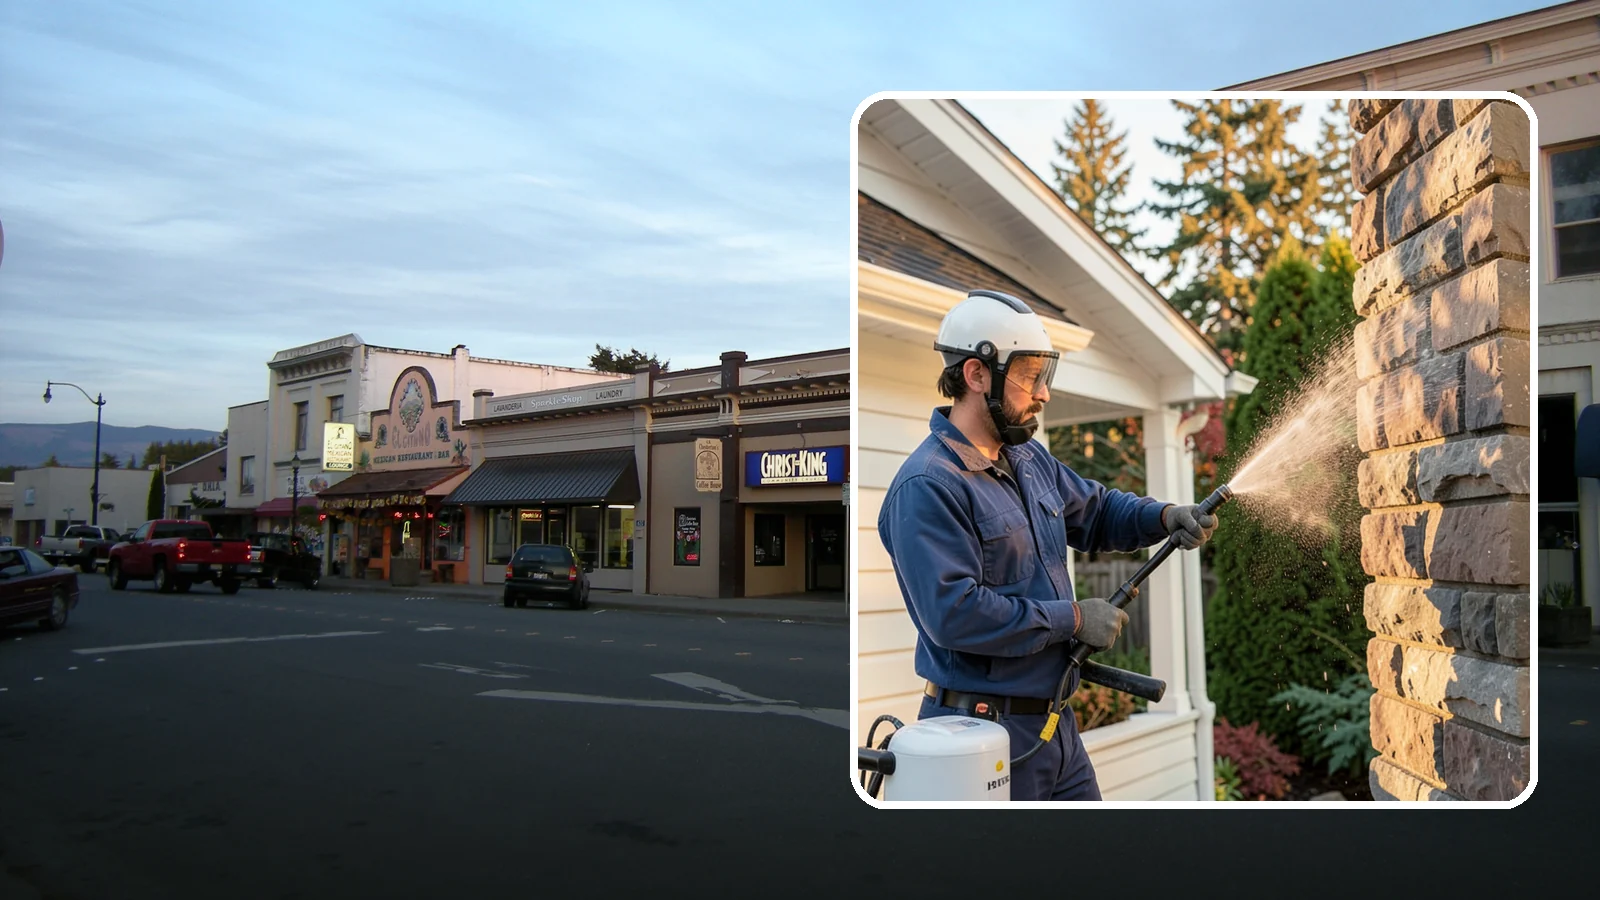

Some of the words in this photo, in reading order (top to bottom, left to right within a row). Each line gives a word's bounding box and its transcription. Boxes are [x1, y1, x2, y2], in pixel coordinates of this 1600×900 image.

[493, 402, 522, 412] LAVANDERIA
[561, 394, 582, 406] Shop
[595, 389, 623, 400] LAUNDRY
[373, 454, 396, 464] MEXICAN
[397, 451, 433, 462] RESTAURANT
[437, 450, 450, 459] BAR
[760, 452, 798, 478] CHRIST
[798, 450, 827, 476] KING
